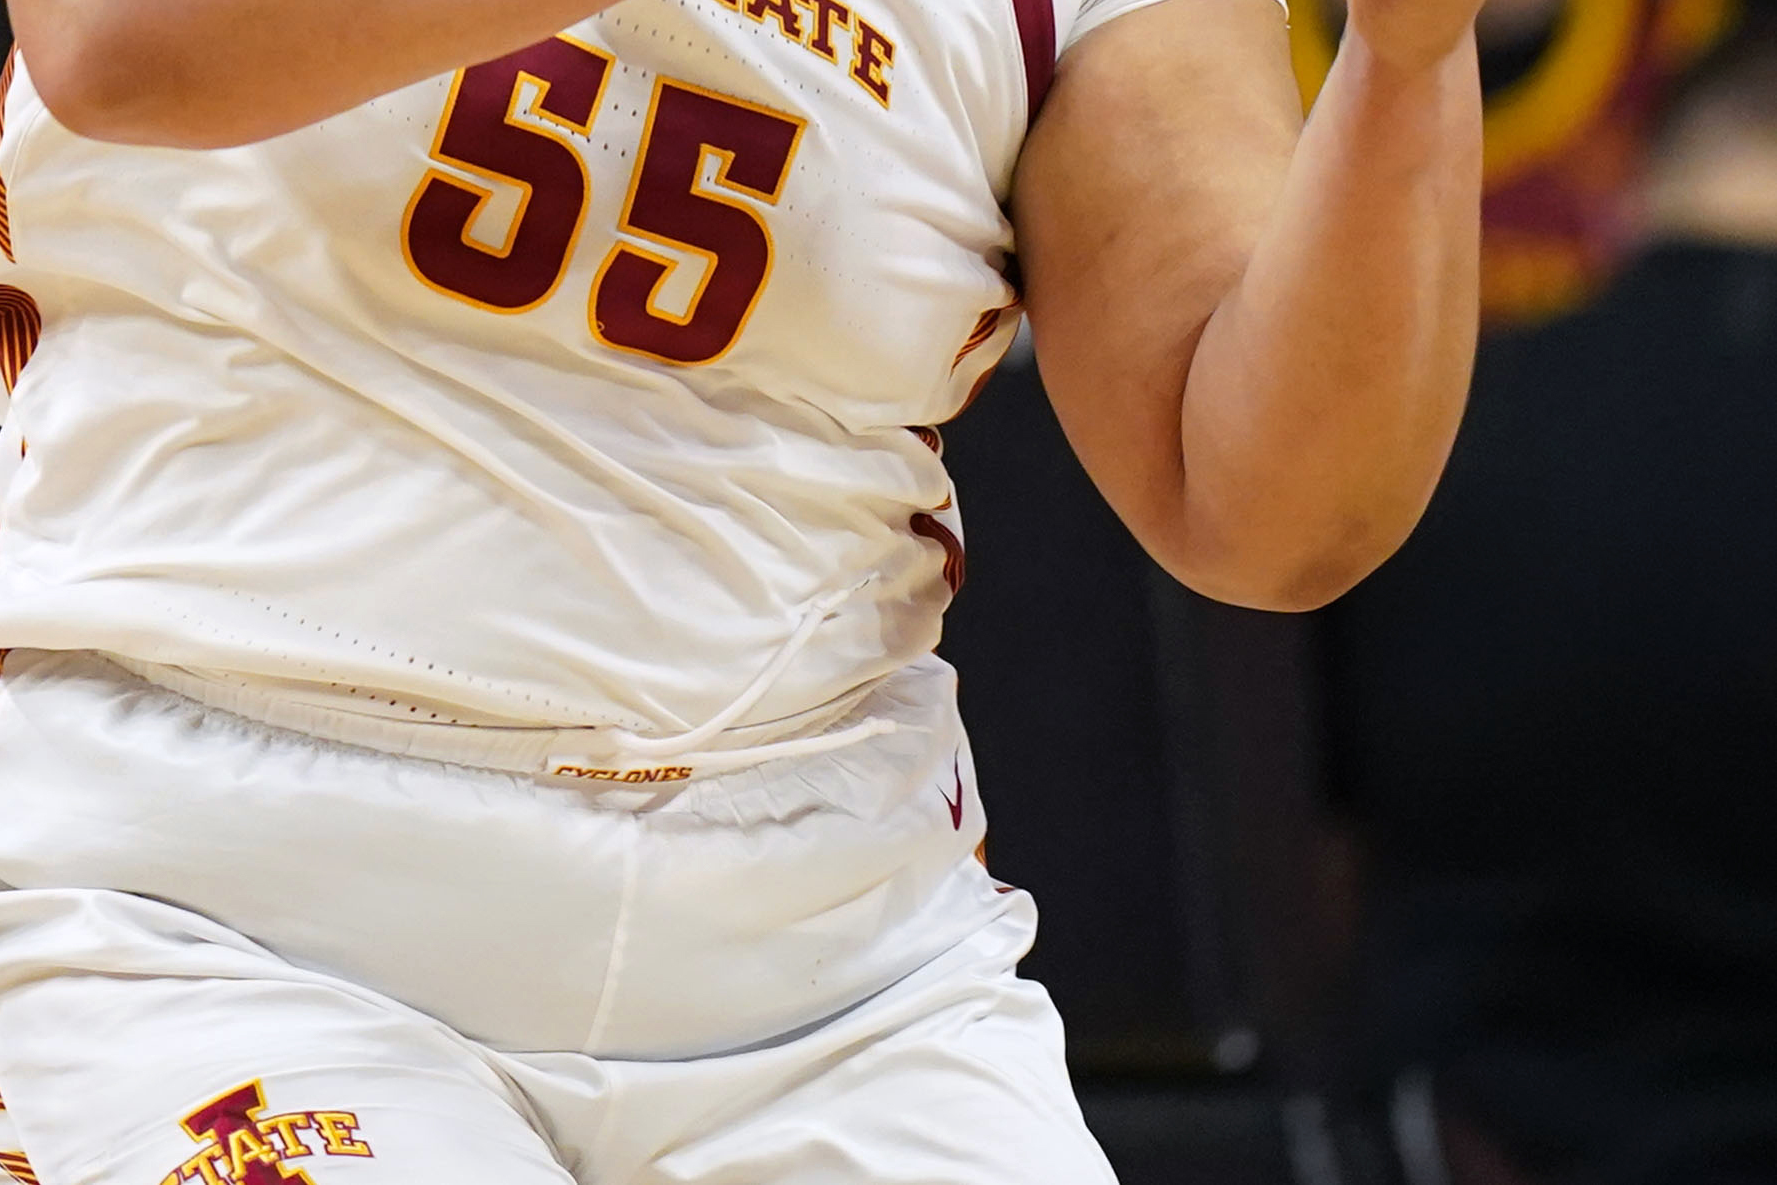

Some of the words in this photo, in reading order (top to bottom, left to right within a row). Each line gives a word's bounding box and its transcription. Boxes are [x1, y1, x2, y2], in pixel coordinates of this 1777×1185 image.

[401, 32, 808, 367] 55
[554, 764, 694, 784] CYCLONES
[159, 1109, 376, 1185] TATE
